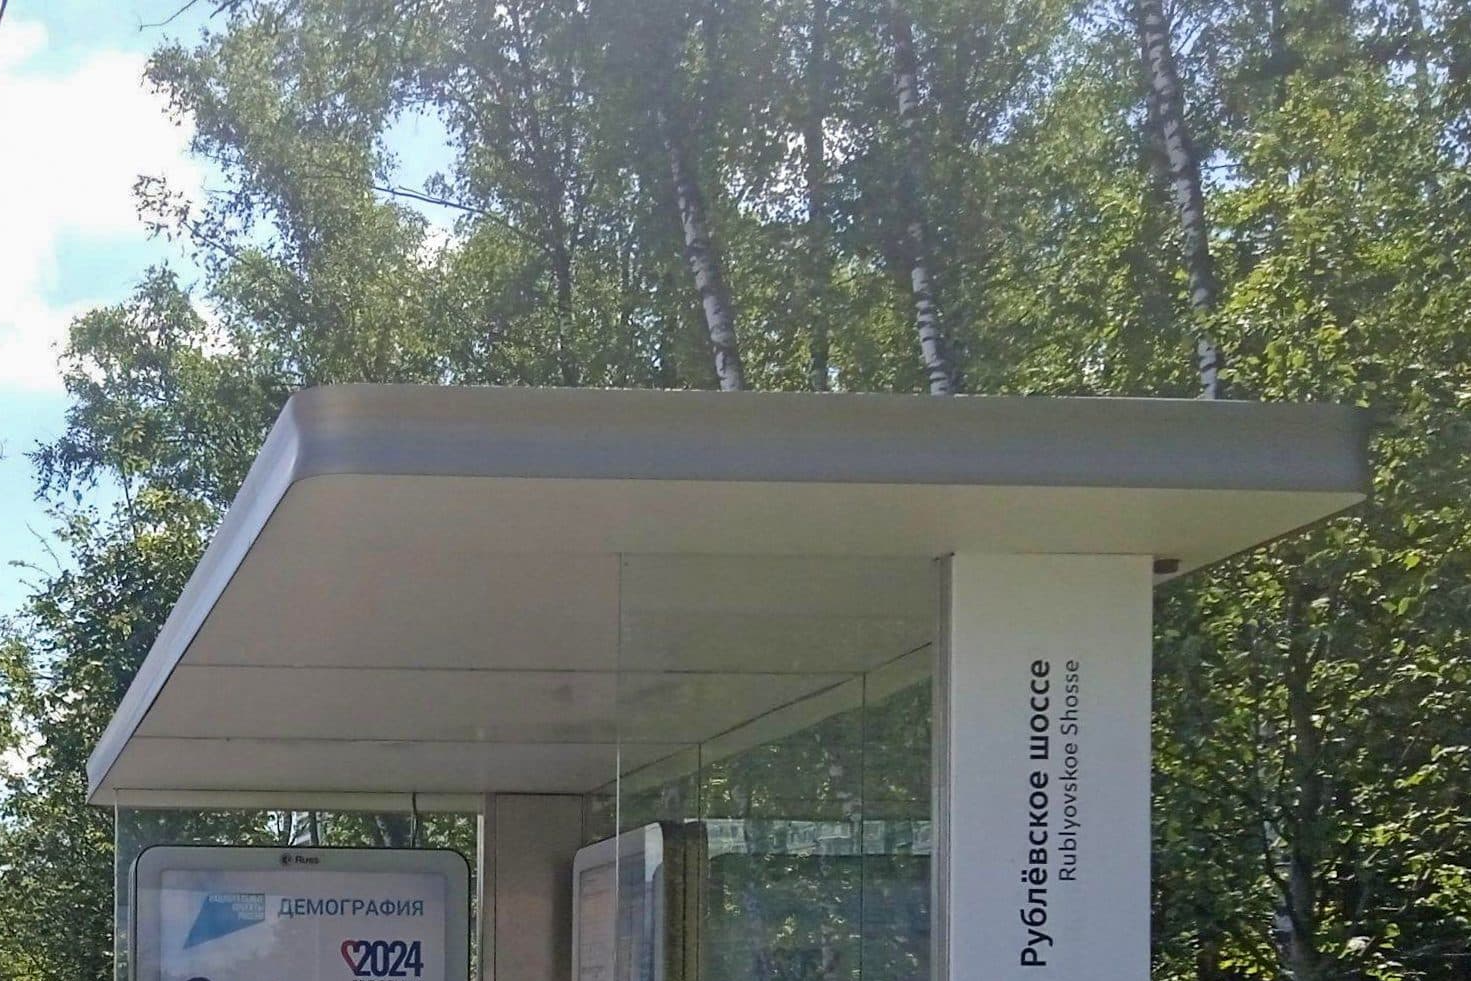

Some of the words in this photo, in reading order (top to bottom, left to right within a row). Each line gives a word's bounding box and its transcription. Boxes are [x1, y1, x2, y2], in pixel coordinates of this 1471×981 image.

[1029, 659, 1050, 760] шоссе
[1060, 659, 1080, 736] Shosse
[1058, 742, 1081, 881] Rublyovskoe
[277, 898, 424, 917] ДЕМОГРАФИЯ
[1020, 771, 1053, 967] Рублёвское
[353, 940, 424, 977] 2024
